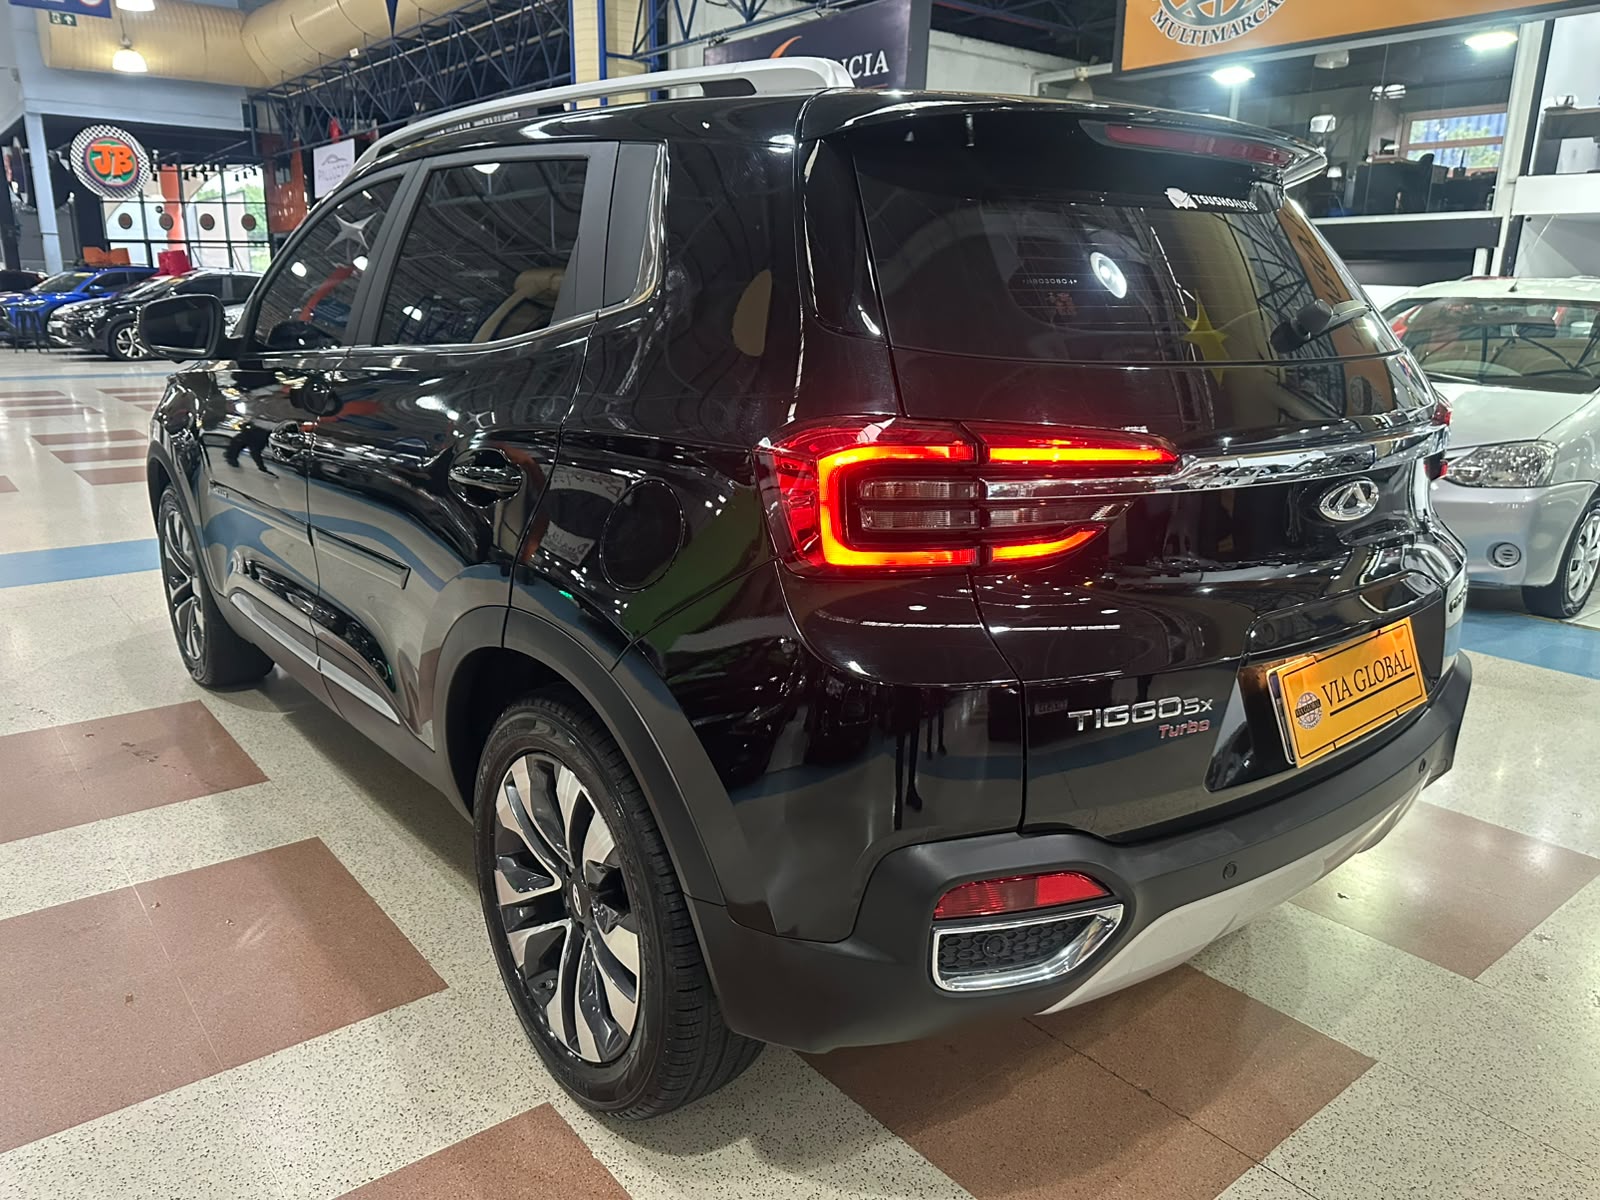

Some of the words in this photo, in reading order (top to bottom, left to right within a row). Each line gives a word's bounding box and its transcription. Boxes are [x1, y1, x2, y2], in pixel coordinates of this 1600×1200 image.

[91, 144, 133, 176] JB
[1321, 675, 1353, 707] VIA
[1353, 649, 1412, 692] GLOBAL
[1158, 719, 1210, 739] Turbo
